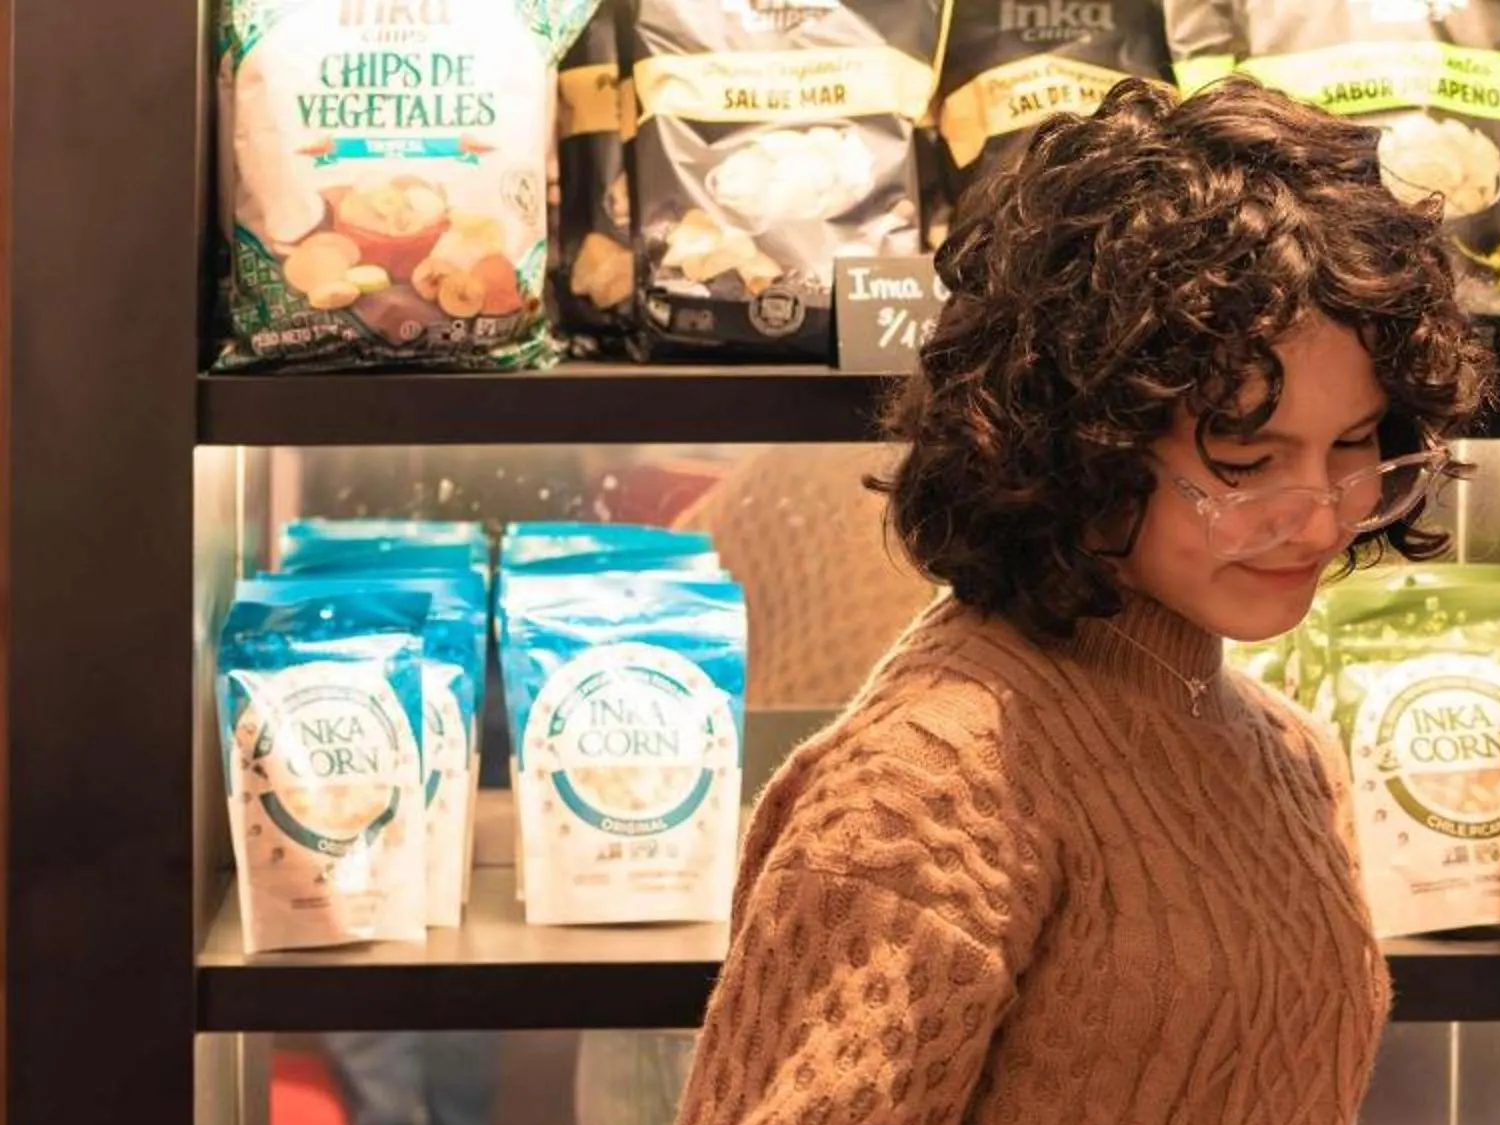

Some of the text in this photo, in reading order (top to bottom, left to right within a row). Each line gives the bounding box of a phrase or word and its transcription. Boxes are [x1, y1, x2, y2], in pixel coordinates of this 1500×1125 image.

[320, 52, 475, 88] CHIPS DE
[723, 84, 847, 110] SAL DE MAR
[1008, 91, 1044, 118] SAL
[1047, 84, 1073, 107] DE
[1321, 76, 1393, 106] SABOR
[297, 92, 496, 128] VEGETALES
[589, 699, 667, 728] INKA
[1411, 703, 1495, 735] INKA
[300, 716, 366, 745] NKA
[577, 729, 680, 758] CORN
[1427, 815, 1466, 837] CHILE
